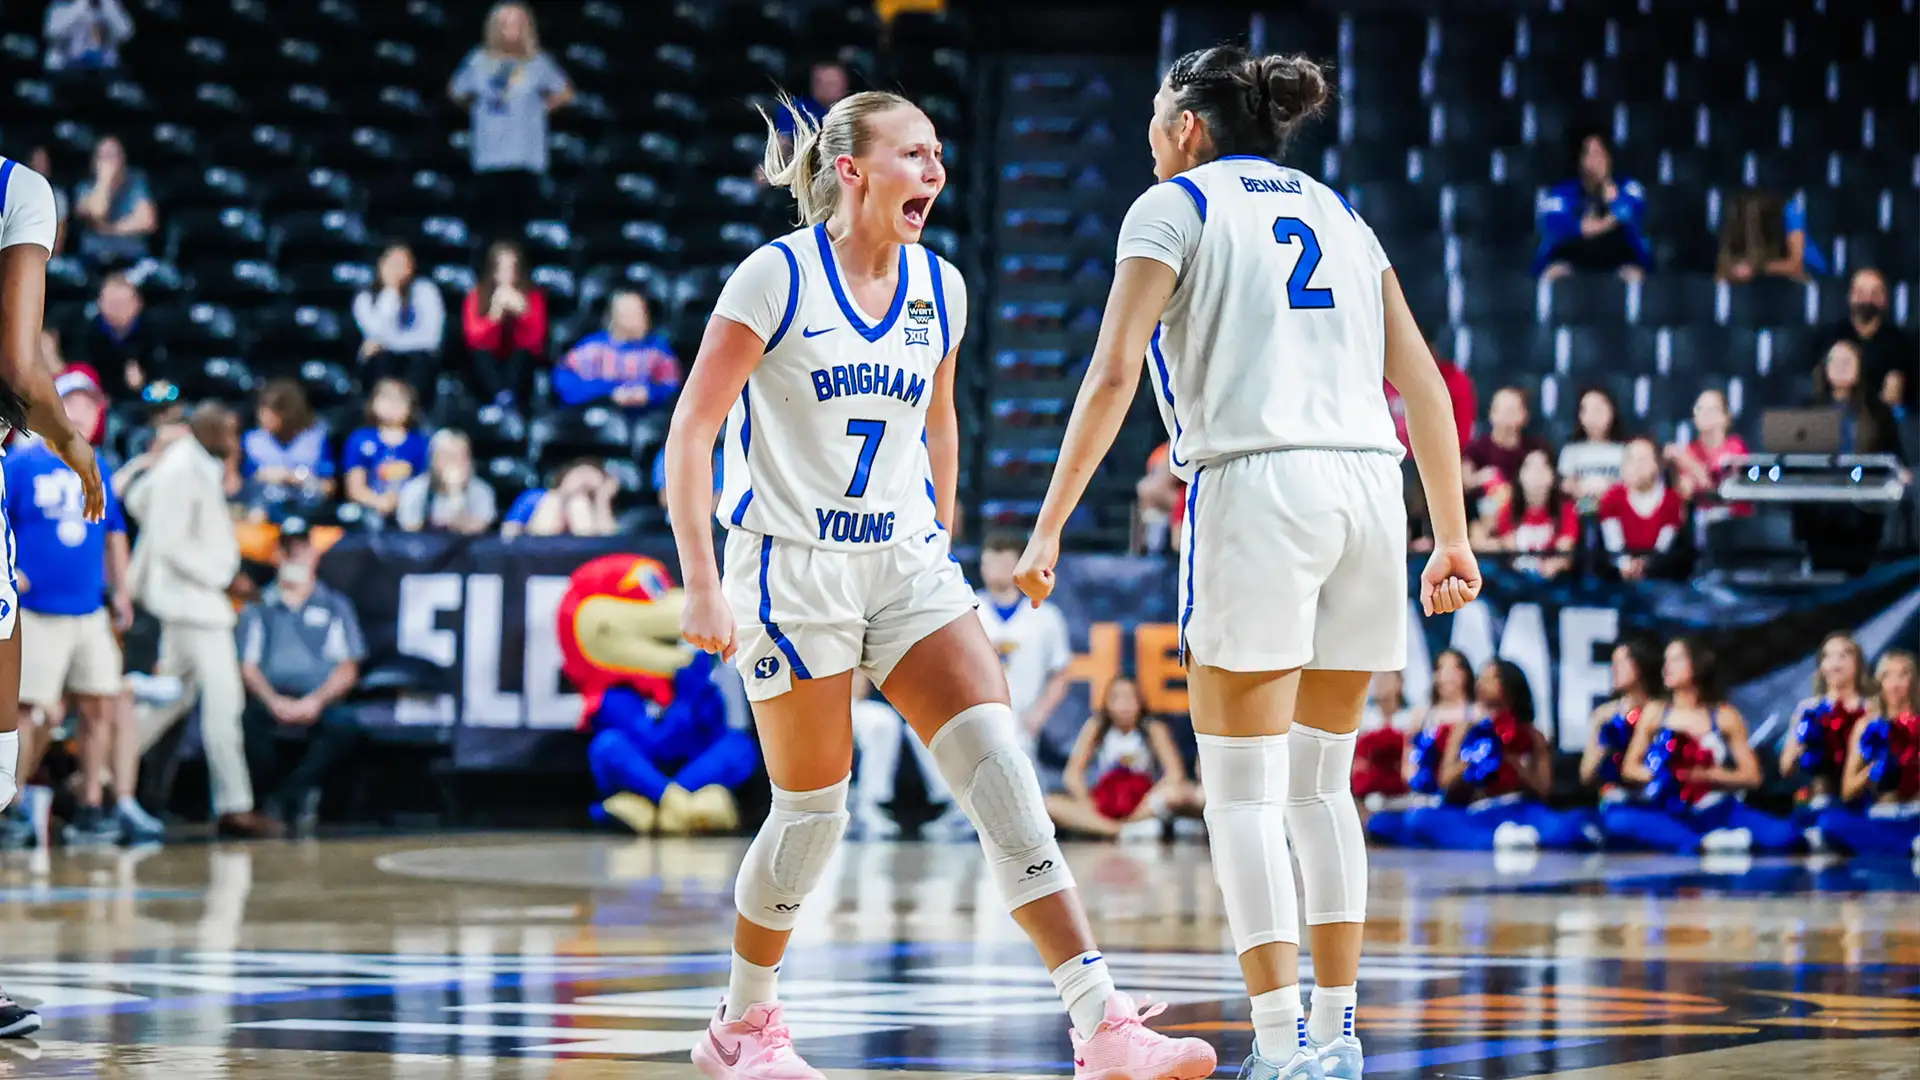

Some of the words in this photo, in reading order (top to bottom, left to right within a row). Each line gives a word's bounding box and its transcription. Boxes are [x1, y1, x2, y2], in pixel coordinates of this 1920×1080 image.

[1240, 176, 1302, 195] BENALLY
[1272, 216, 1335, 309] 2
[811, 363, 926, 407] BRIGHAM
[844, 418, 887, 498] 7
[816, 508, 895, 543] YOUNG
